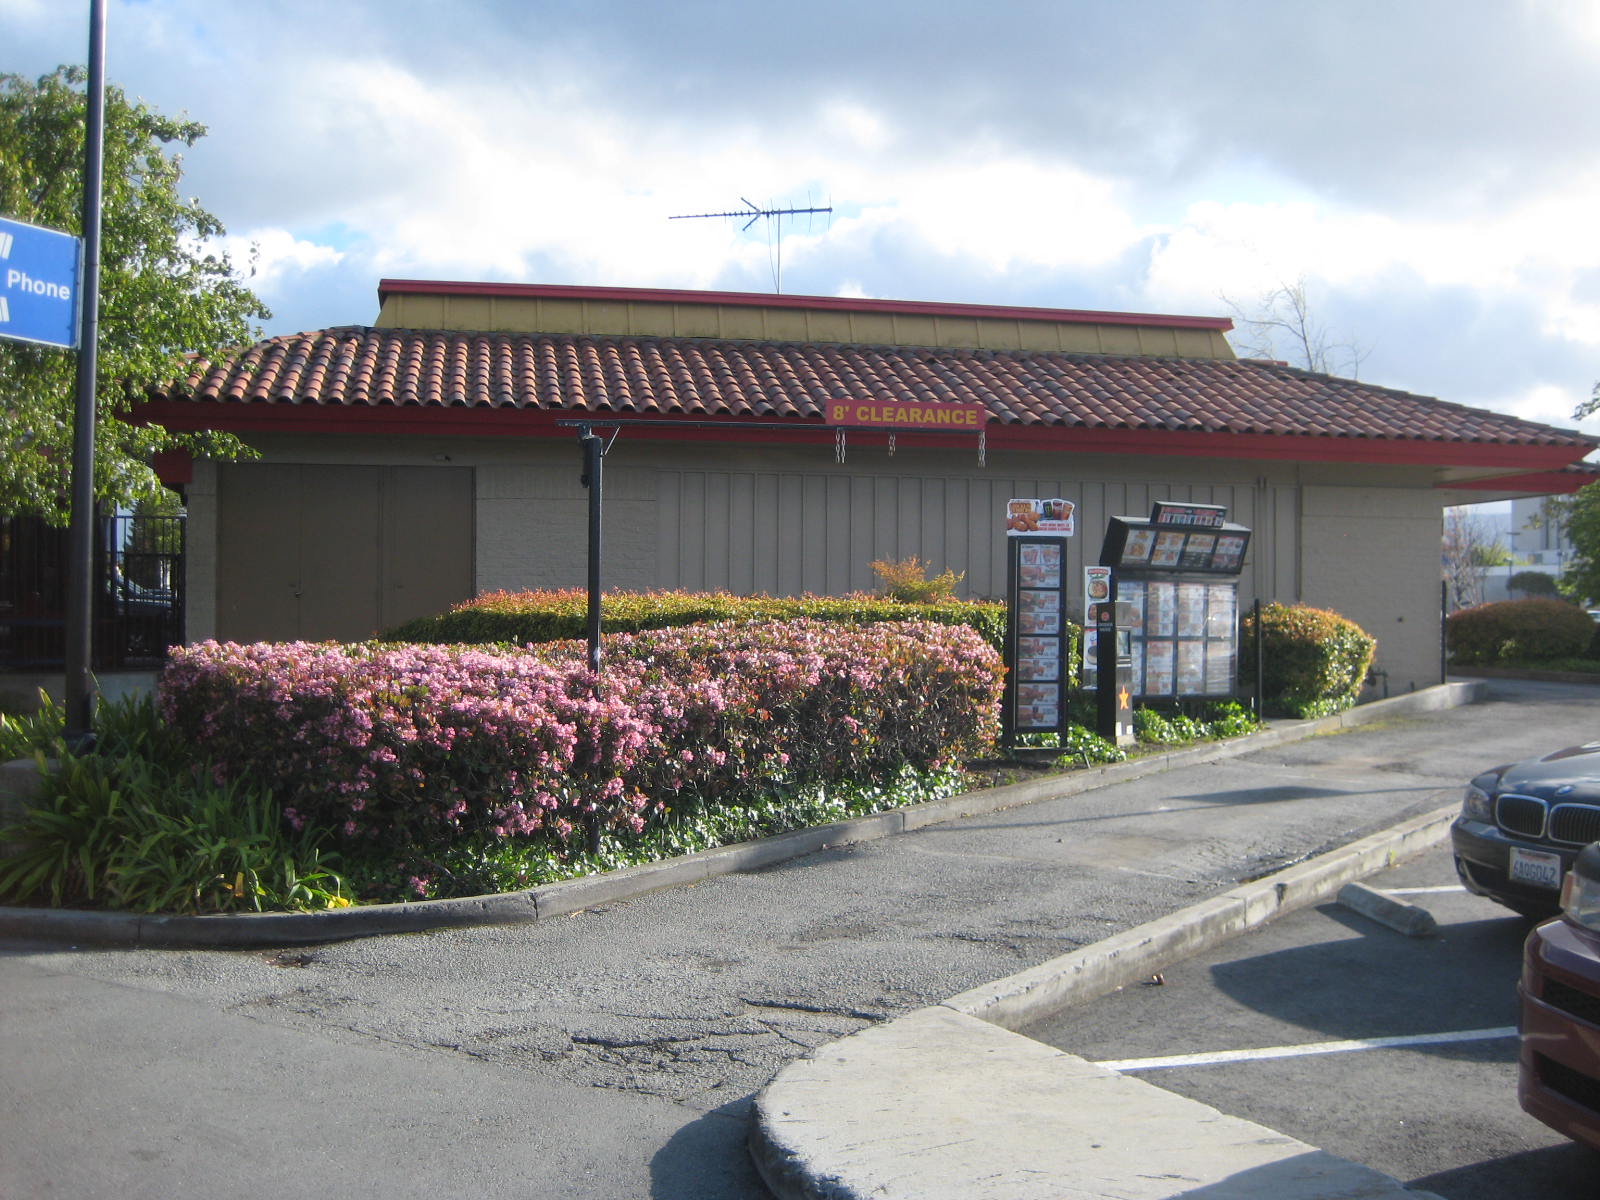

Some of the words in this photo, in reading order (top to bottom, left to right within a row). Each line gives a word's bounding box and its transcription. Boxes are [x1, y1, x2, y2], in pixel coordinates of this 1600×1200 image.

[7, 269, 71, 300] Phone
[832, 405, 850, 421] 8'
[856, 406, 978, 425] CLEARANCE
